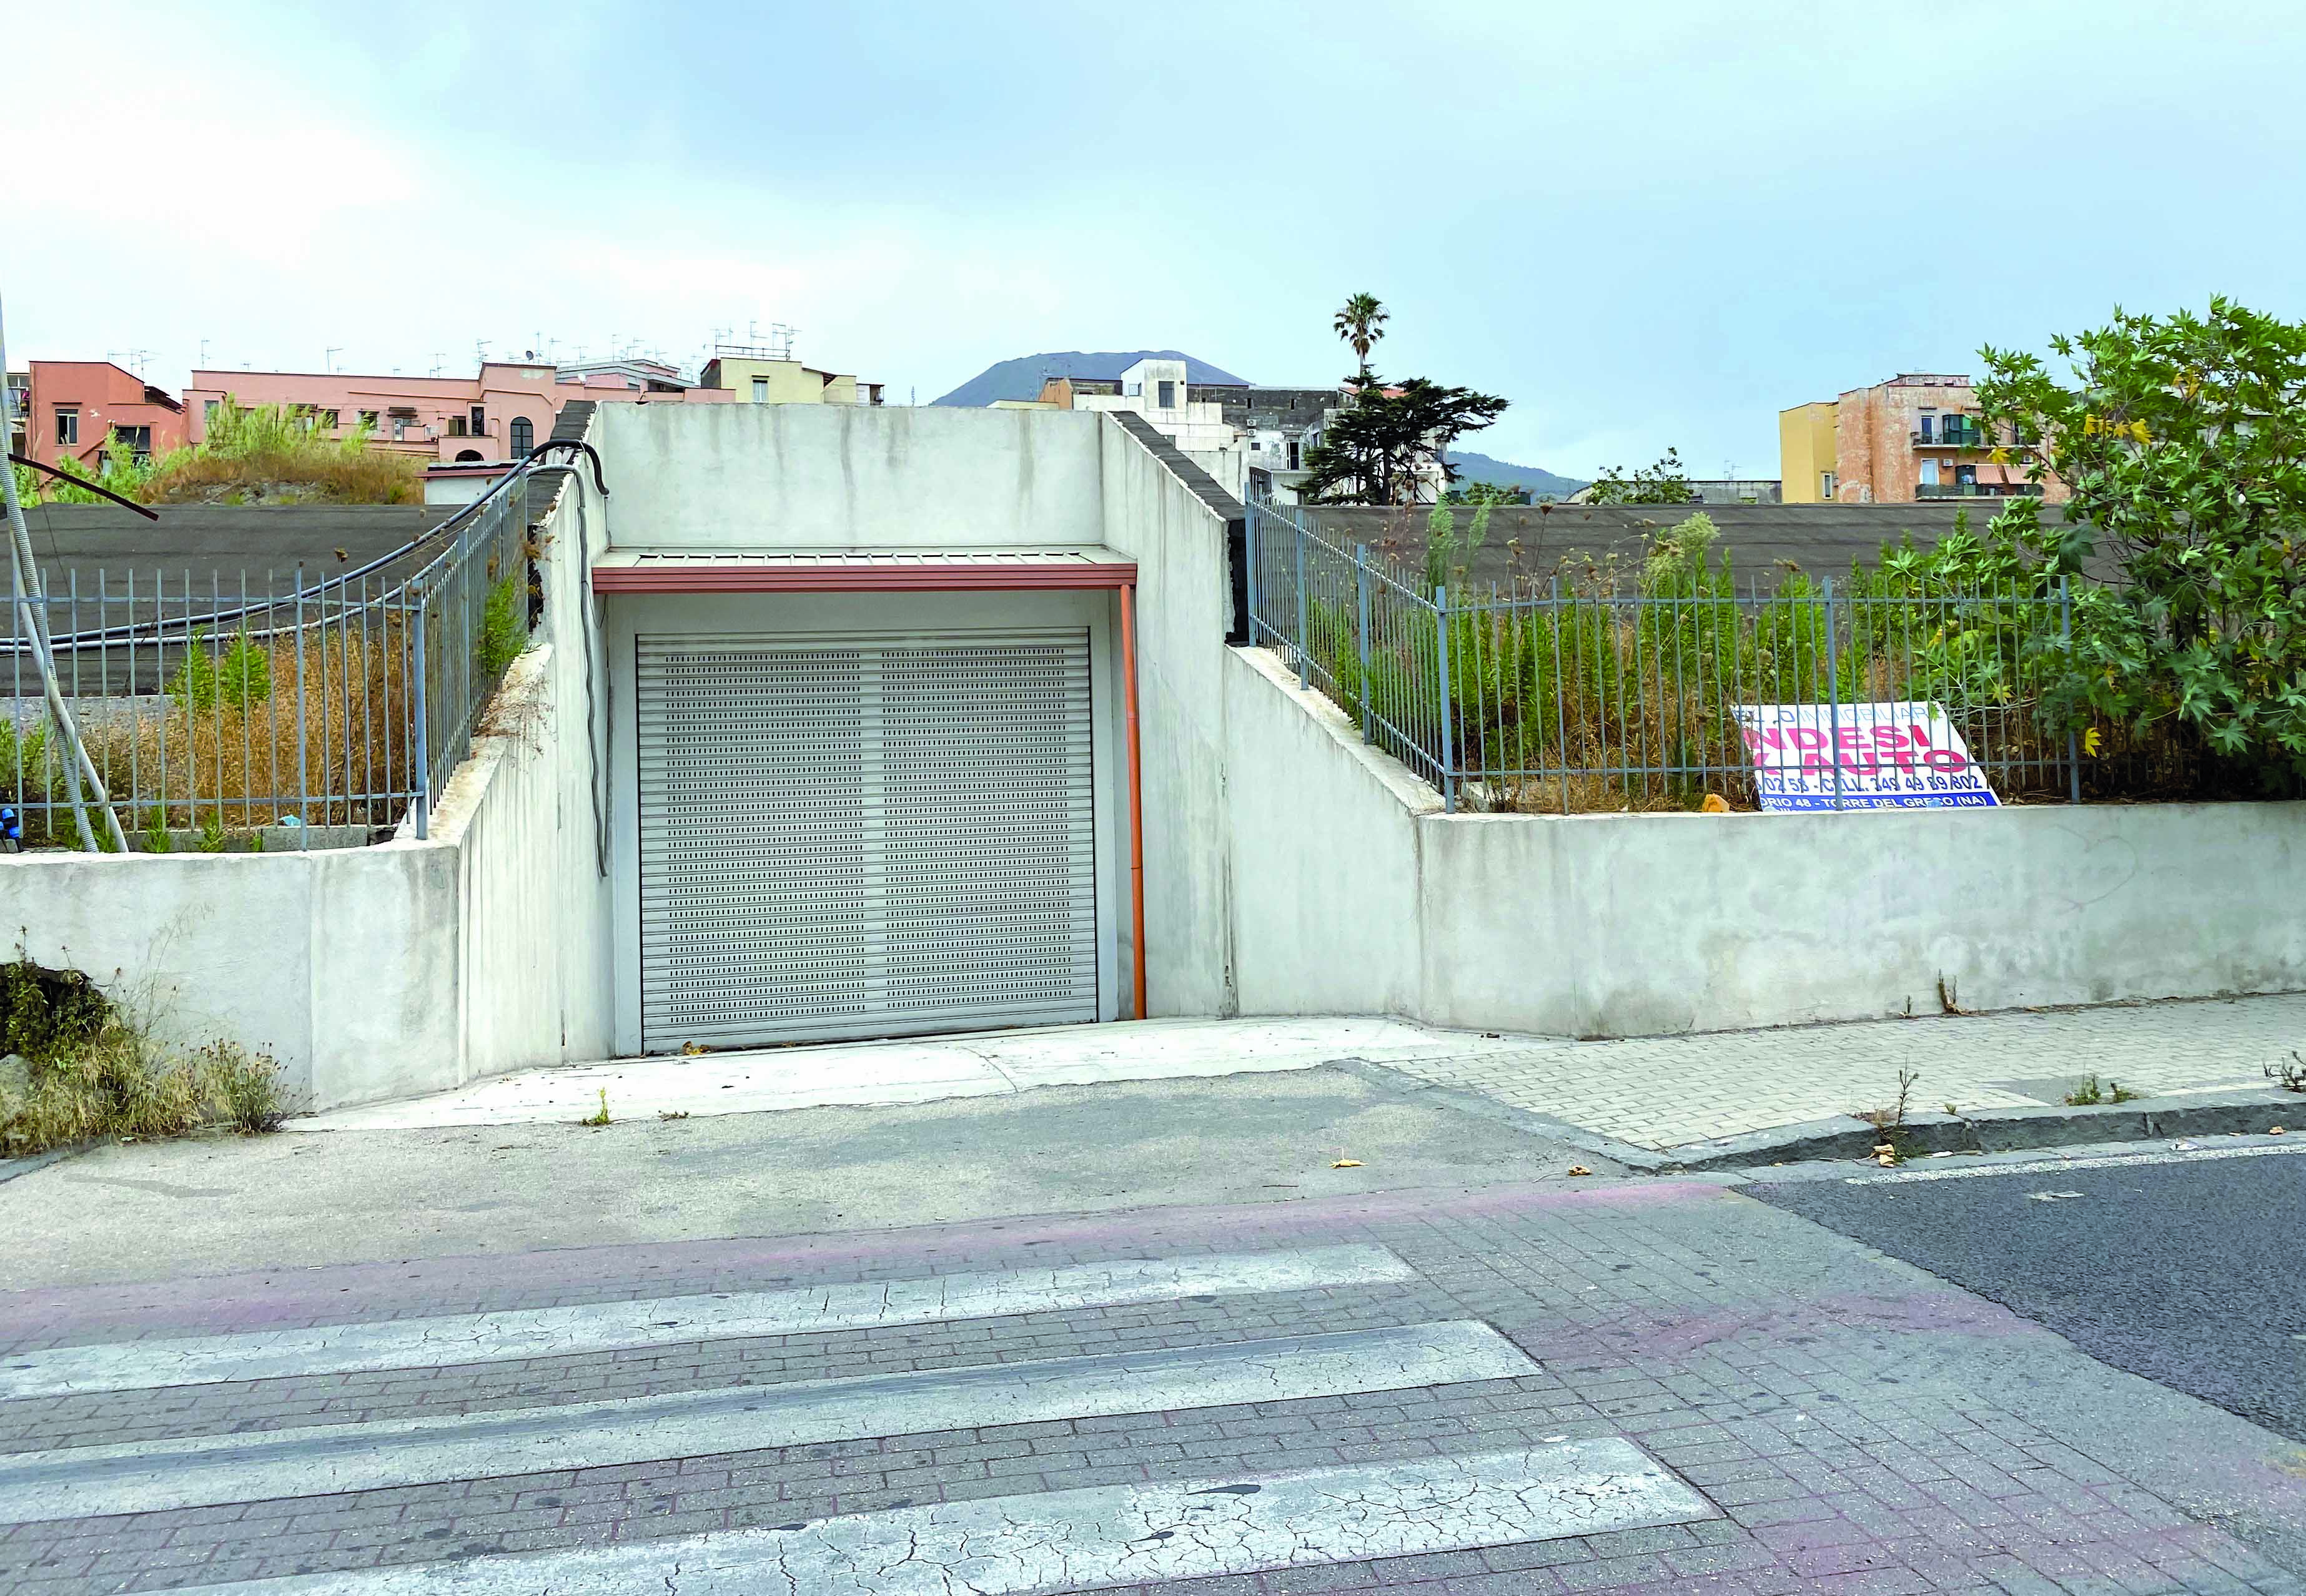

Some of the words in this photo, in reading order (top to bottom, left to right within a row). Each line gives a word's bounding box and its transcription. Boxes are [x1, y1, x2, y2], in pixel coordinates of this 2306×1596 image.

[1802, 749, 1967, 776] AUTO
[1906, 776, 1924, 791] 49
[1926, 776, 1948, 790] 89
[1951, 774, 1983, 789] 802
[1796, 799, 1812, 808] 48
[1871, 799, 1903, 807] DEL
[1956, 795, 1987, 806] (NA)
